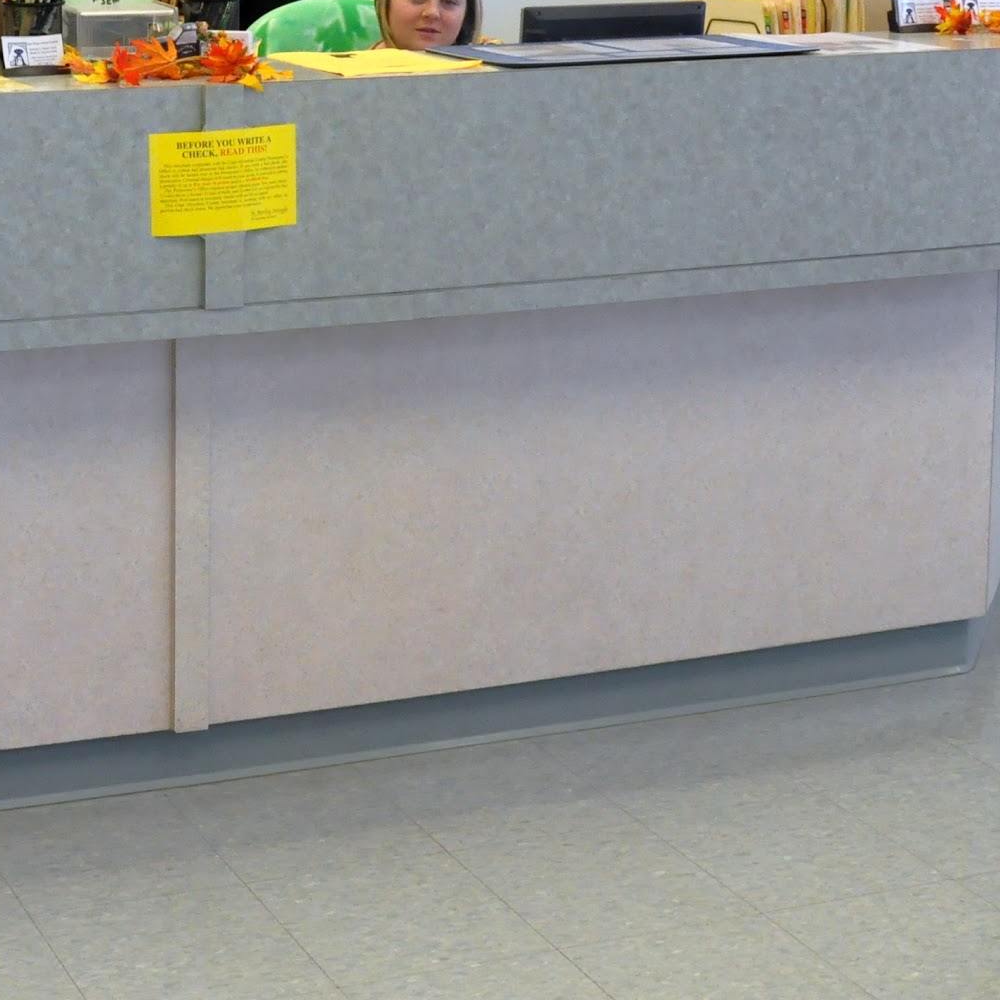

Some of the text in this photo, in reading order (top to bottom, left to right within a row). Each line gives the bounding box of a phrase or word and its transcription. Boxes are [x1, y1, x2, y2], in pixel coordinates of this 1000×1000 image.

[176, 141, 214, 150] BEFORE
[216, 139, 235, 148] YOU
[237, 136, 264, 145] WRITE
[182, 145, 268, 158] CHECK, READ THIS!
